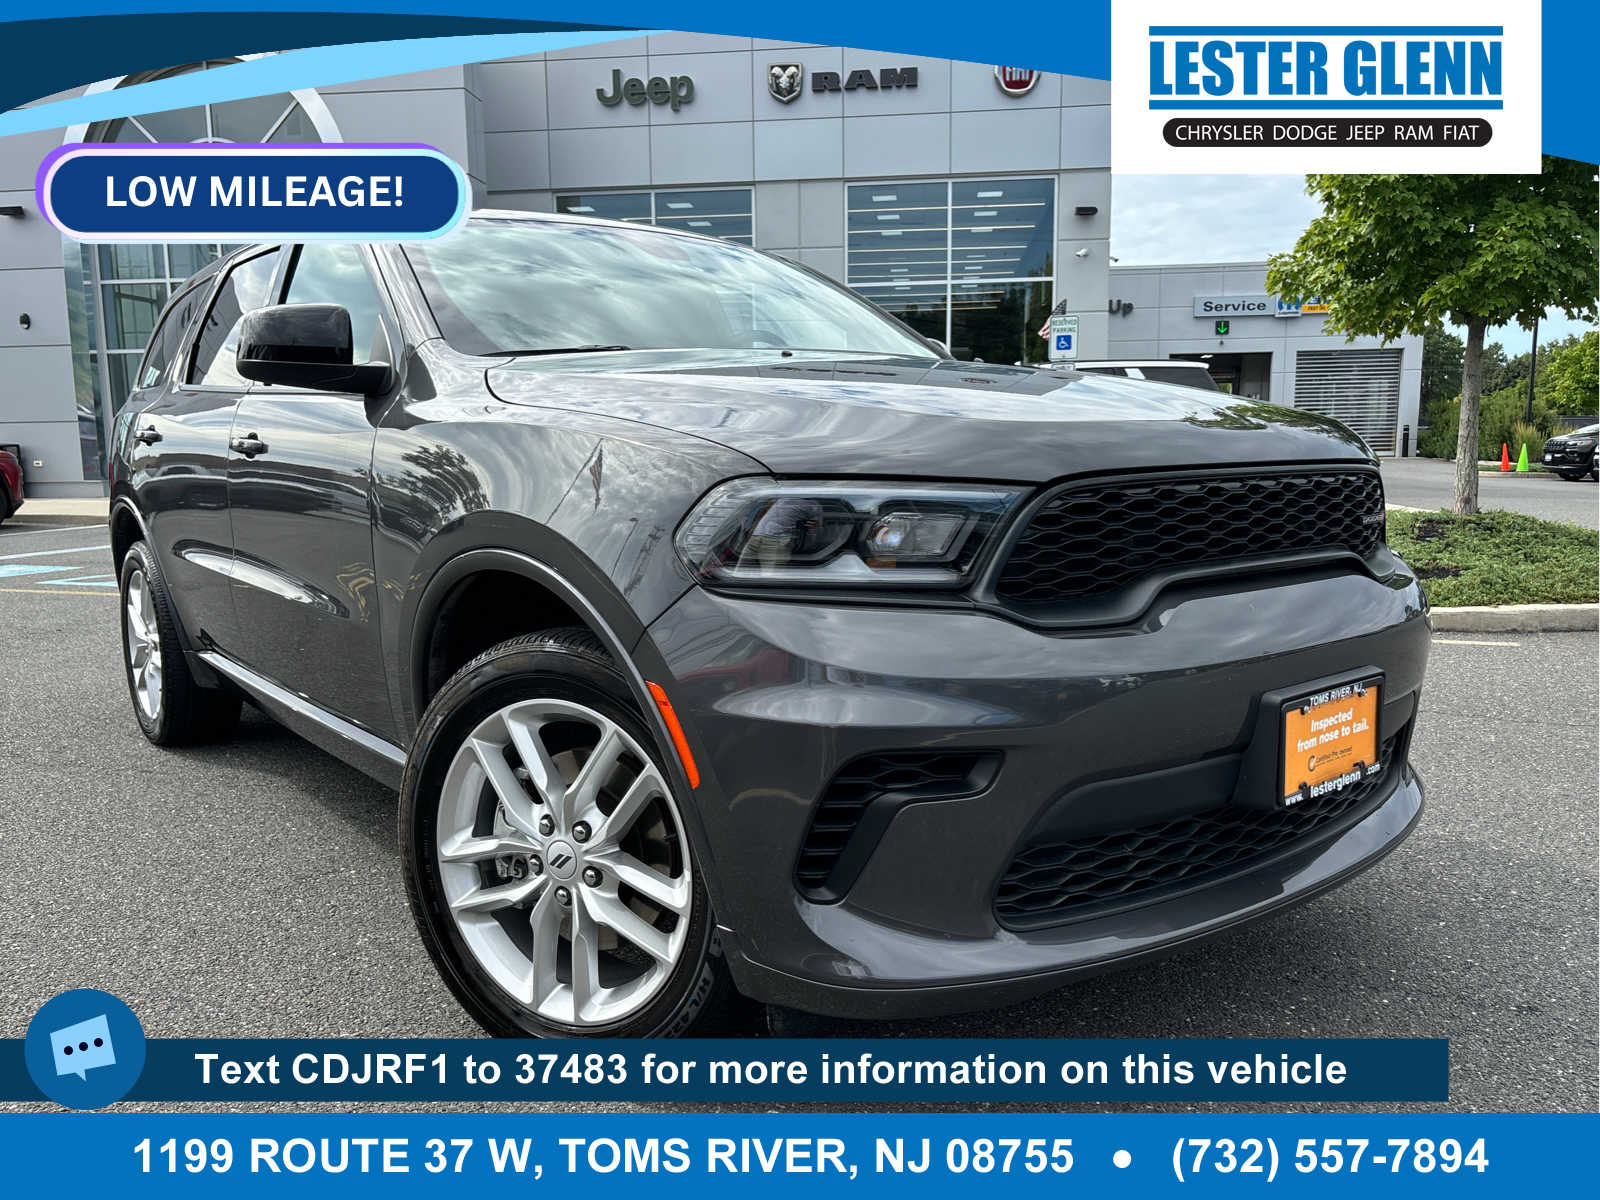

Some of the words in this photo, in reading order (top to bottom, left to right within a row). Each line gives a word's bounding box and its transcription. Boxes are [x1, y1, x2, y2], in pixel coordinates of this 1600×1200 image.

[596, 69, 694, 112] Jeep
[812, 67, 918, 92] RAM
[1108, 299, 1134, 318] Up
[1203, 300, 1267, 313] Service
[1309, 695, 1329, 707] TOMS
[1353, 682, 1364, 694] NJ
[1311, 708, 1353, 732] Inspected
[1297, 736, 1318, 753] from
[1319, 729, 1339, 745] nose
[1341, 725, 1351, 737] to
[1352, 718, 1369, 734] tail.
[1310, 771, 1361, 798] lesterglenn
[1366, 763, 1381, 776] .com
